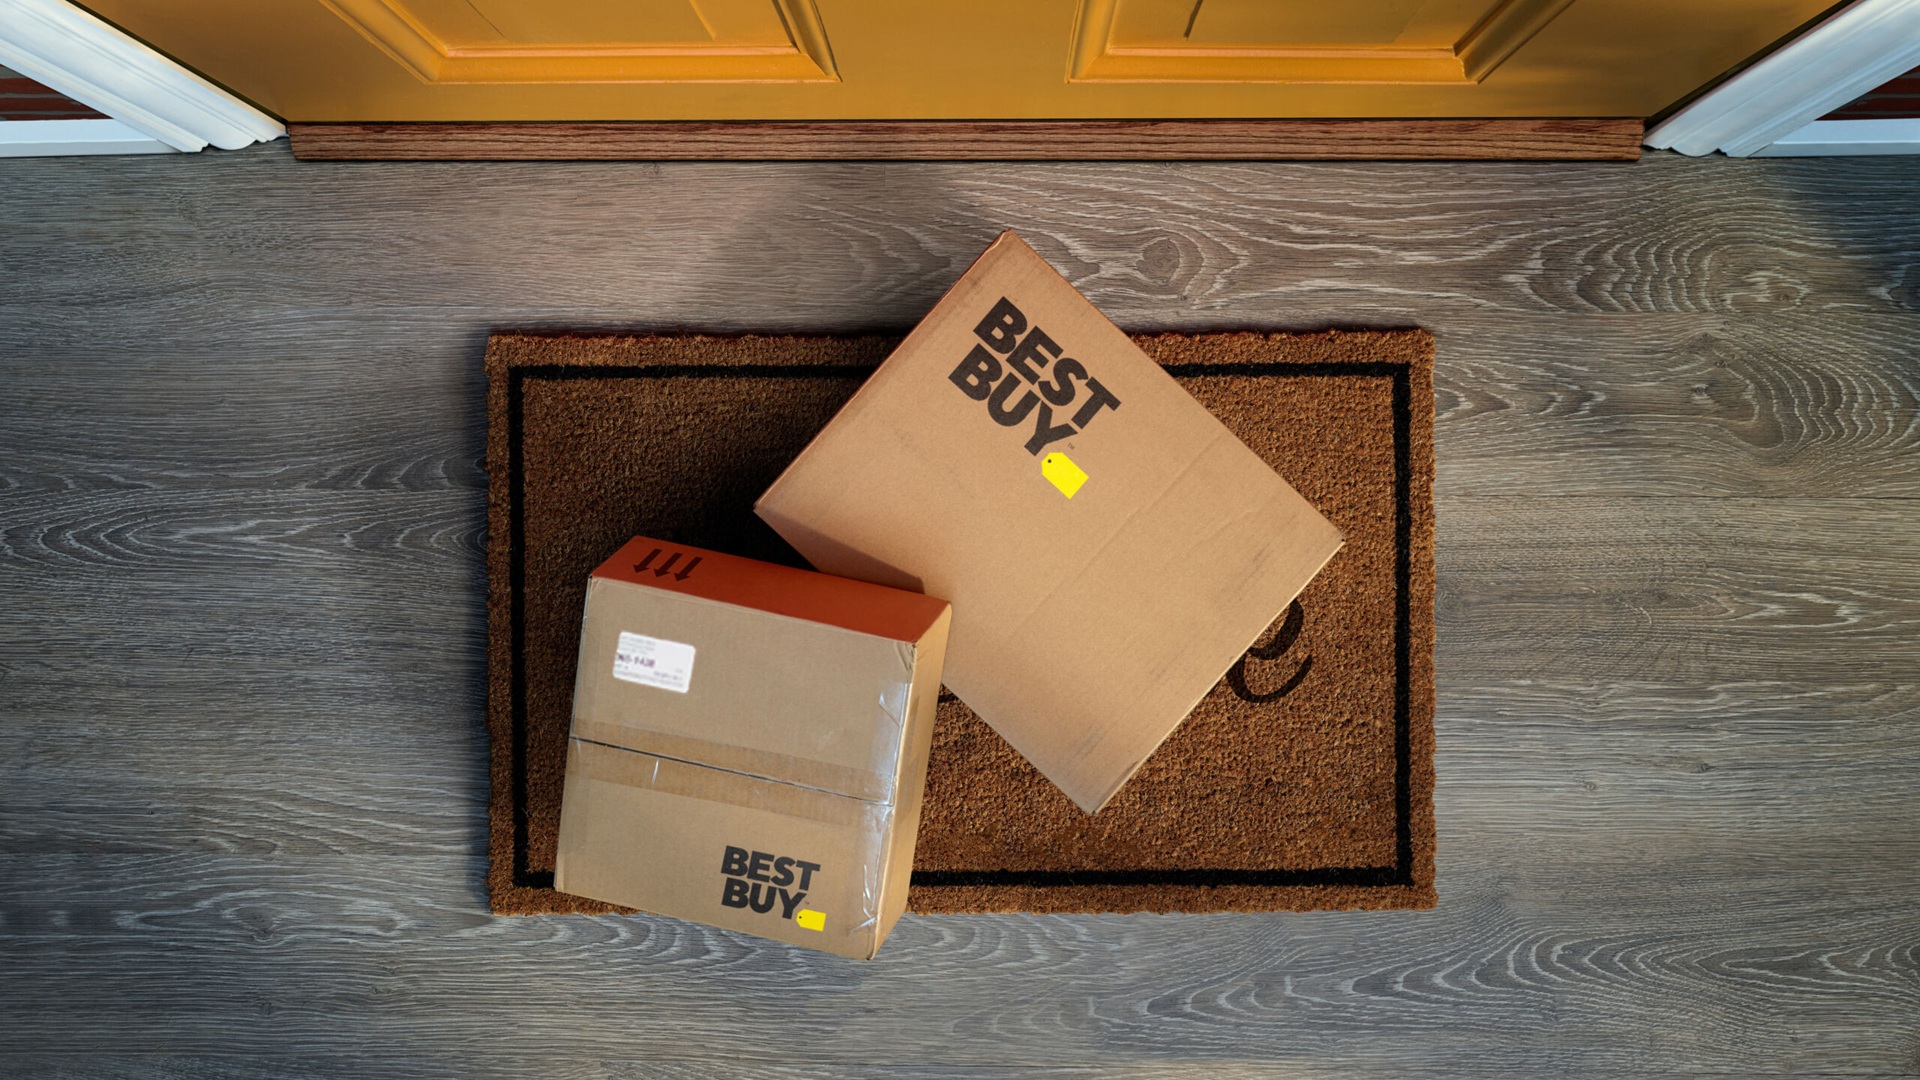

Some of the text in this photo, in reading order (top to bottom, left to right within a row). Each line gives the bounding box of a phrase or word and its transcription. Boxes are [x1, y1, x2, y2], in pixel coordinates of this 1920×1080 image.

[948, 343, 1078, 457] BUY
[973, 296, 1121, 430] BEST
[721, 845, 821, 891] BEST
[721, 877, 807, 920] BUY
